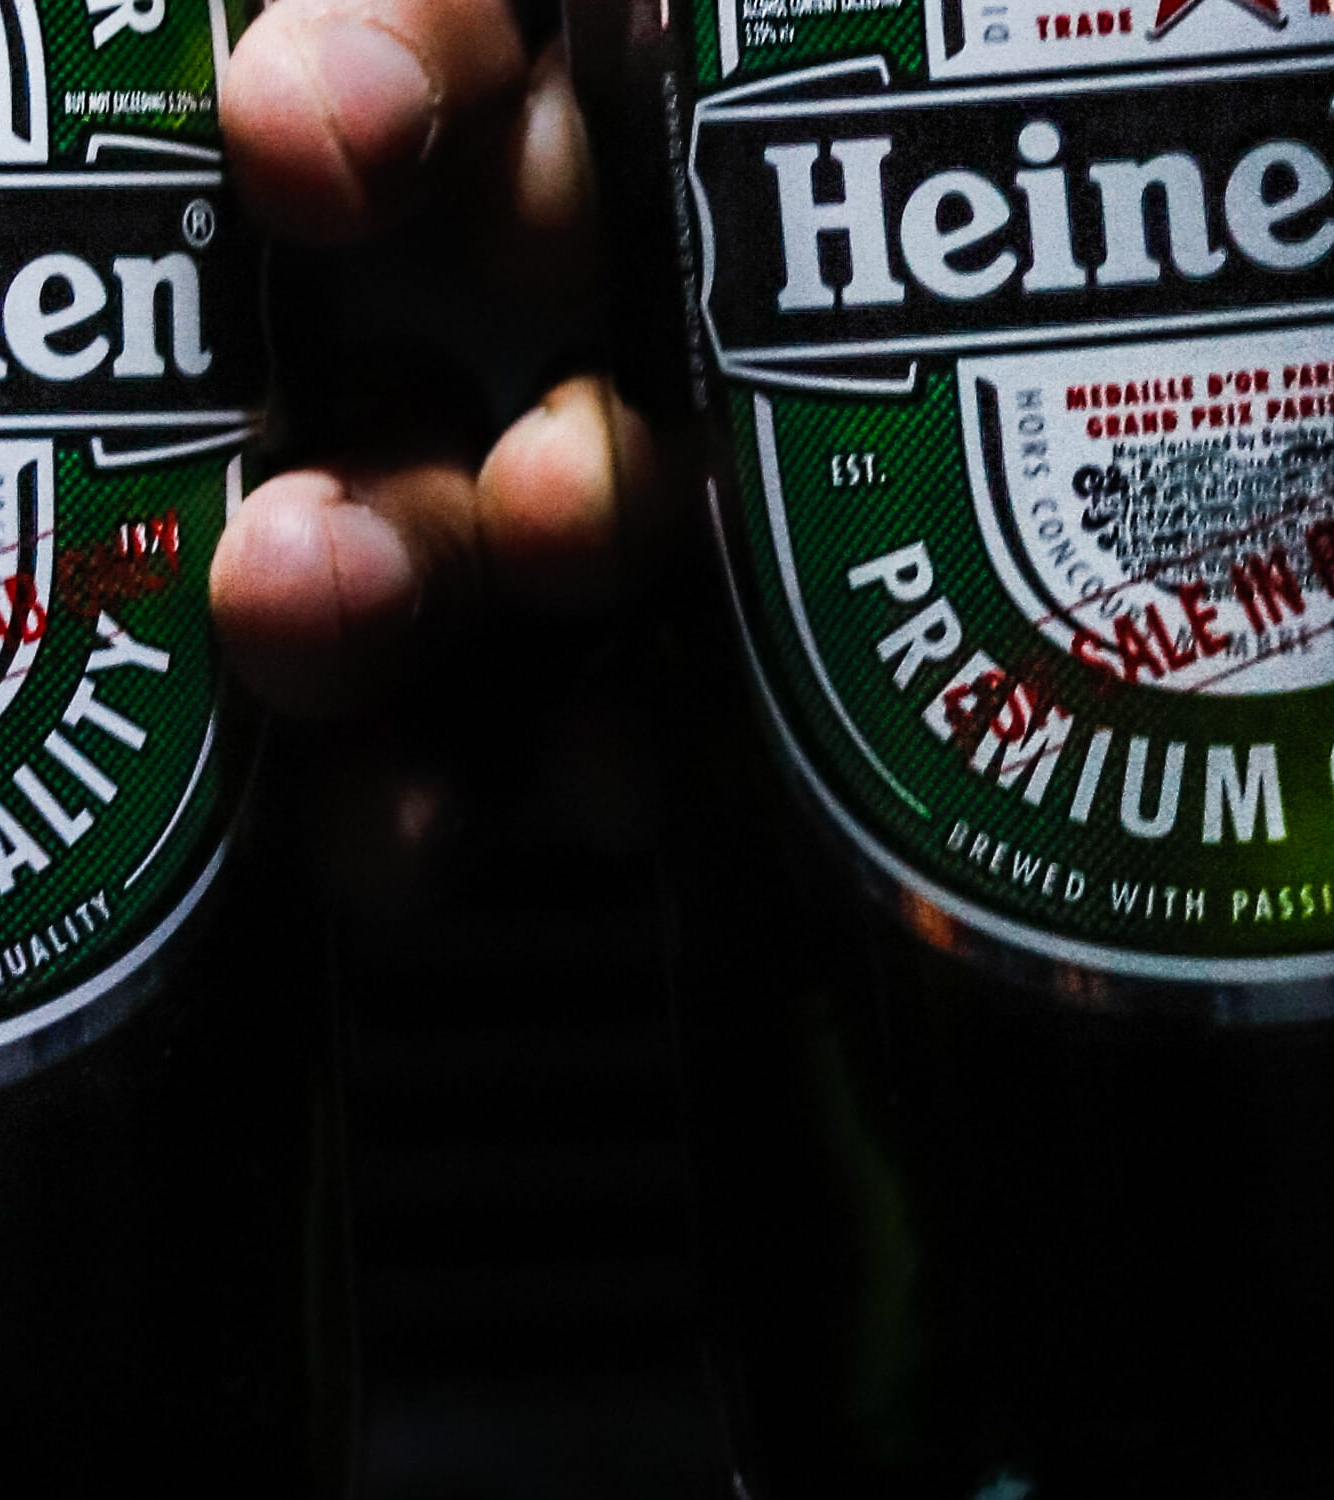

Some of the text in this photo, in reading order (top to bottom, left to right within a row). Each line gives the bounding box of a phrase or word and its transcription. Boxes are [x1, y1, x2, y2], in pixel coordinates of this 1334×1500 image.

[1035, 7, 1133, 42] TRADE
[1085, 406, 1179, 440] GRAND
[1192, 400, 1252, 430] PRIX
[829, 451, 887, 488] EST.
[1071, 577, 1232, 694] SALE
[1230, 544, 1307, 636] IN
[848, 539, 1288, 845] PREMIUM
[944, 818, 1086, 906] BREWED
[1110, 879, 1206, 923] WITH
